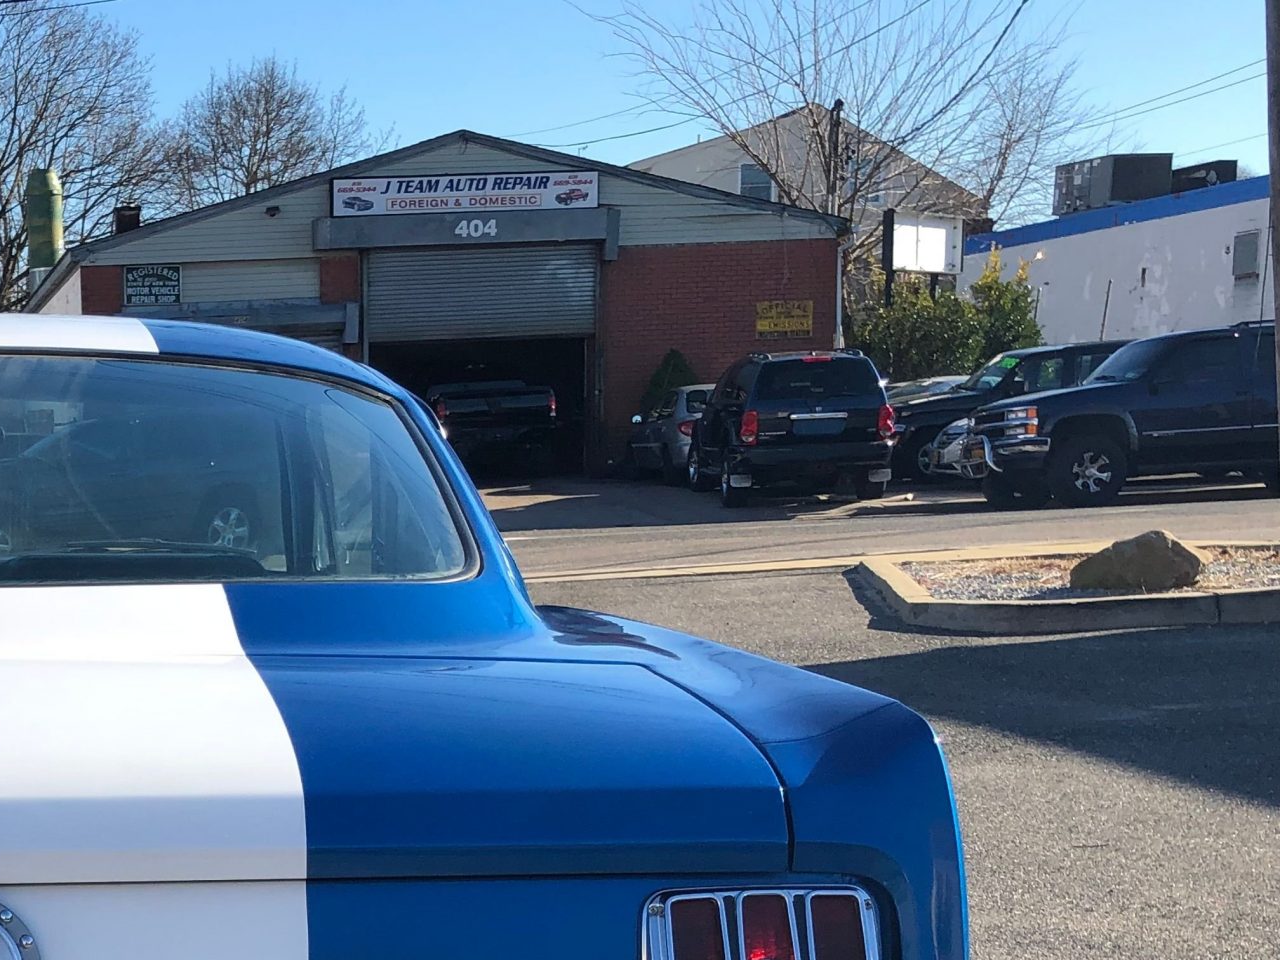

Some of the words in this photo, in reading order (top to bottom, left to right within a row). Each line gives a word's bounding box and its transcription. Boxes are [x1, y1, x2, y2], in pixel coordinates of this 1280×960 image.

[380, 181, 391, 195] J
[396, 179, 440, 194] TEAM
[442, 177, 488, 193] AUTO
[491, 176, 550, 191] REPAIR
[390, 198, 449, 209] FOREIGN
[453, 198, 462, 207] &
[468, 195, 538, 207] DOMESTIC
[454, 219, 498, 238] 404
[127, 266, 179, 280] REGISTERED
[127, 287, 150, 295] MOTOR
[151, 286, 180, 295] VEHICLE
[131, 295, 156, 303] REPAIR
[157, 295, 176, 303] SHOP
